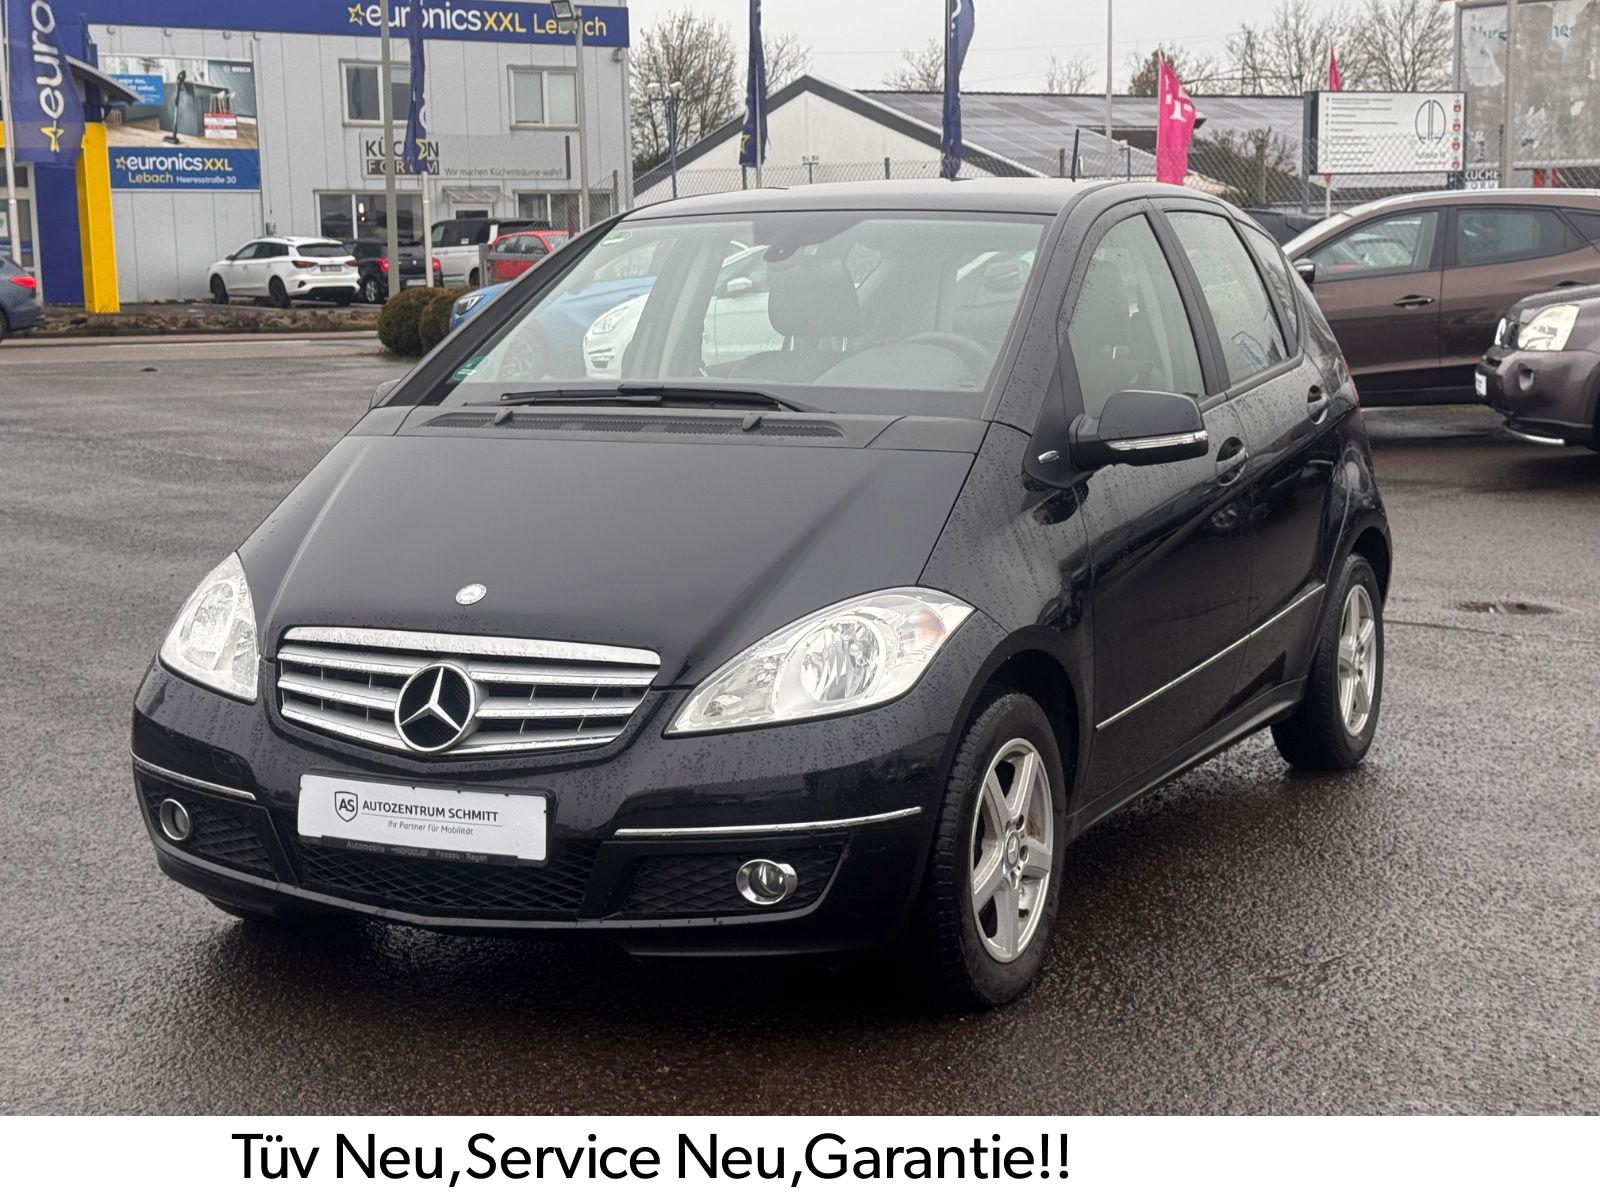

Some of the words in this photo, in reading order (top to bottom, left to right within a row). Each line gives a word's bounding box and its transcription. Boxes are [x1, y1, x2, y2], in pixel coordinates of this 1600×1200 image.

[31, 0, 64, 119] euro
[231, 65, 251, 73] BOSCH
[365, 136, 439, 158] KÜCN
[368, 160, 438, 174] FORM
[444, 167, 458, 177] Wir
[460, 167, 489, 177] machen
[490, 167, 541, 178] Küchenträume
[128, 172, 174, 184] Lebach
[176, 175, 225, 185] Heeresstraße
[226, 175, 237, 185] 30
[338, 798, 356, 813] AS
[362, 800, 446, 818] AUTOZENTRUM
[448, 808, 499, 822] SCHMITT
[387, 820, 398, 829] Ihr
[399, 821, 426, 832] Partner
[427, 823, 439, 834] für
[440, 825, 474, 836] Mobilität
[346, 841, 386, 853] Automobile
